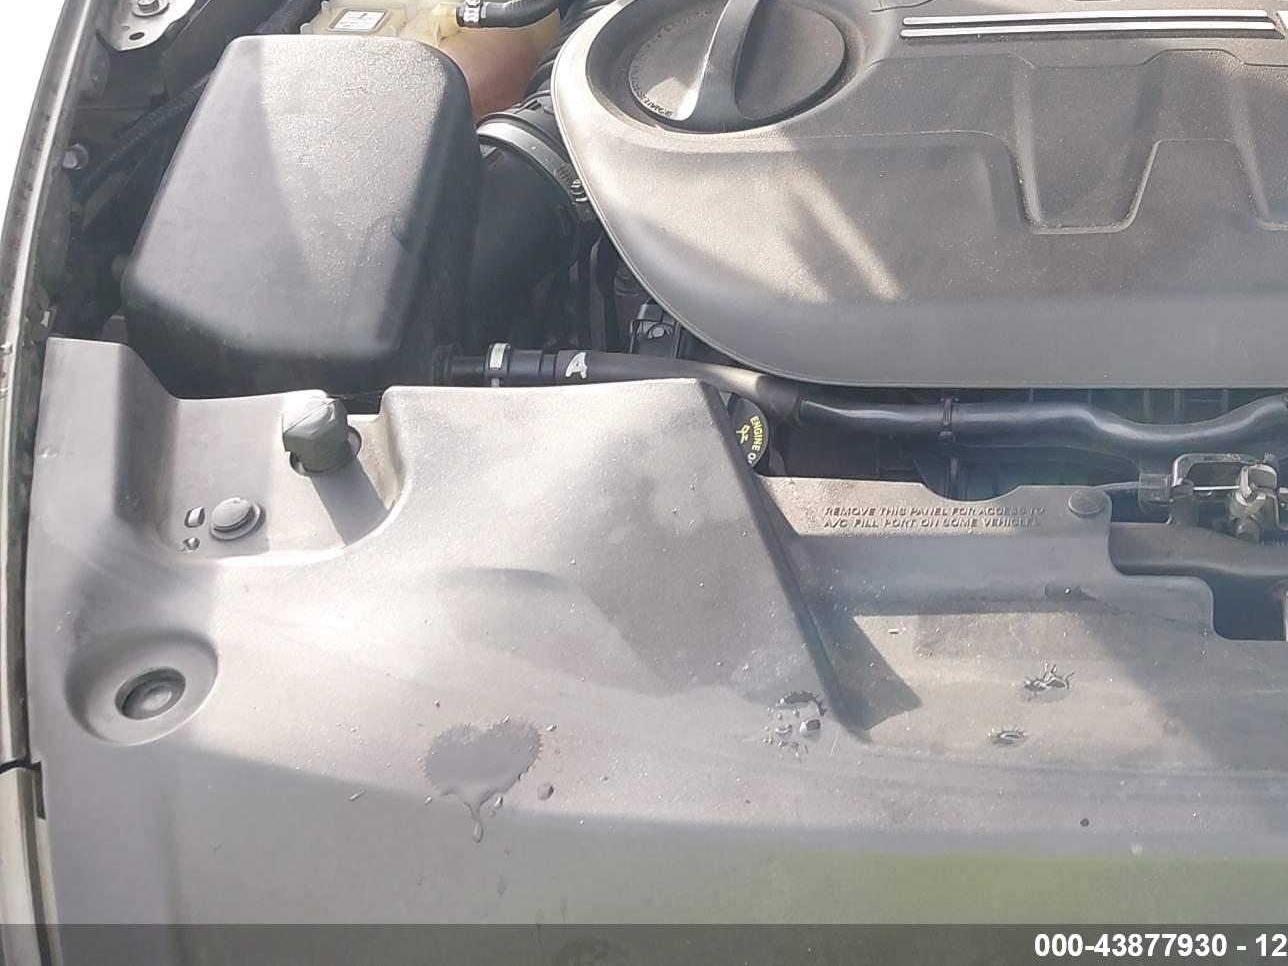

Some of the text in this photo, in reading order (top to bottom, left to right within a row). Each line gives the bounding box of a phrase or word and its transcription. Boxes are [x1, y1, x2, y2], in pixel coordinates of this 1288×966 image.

[565, 351, 589, 379] A
[750, 415, 763, 452] ENGINE
[824, 506, 876, 516] REMOVE
[879, 506, 907, 516] THIS
[910, 507, 948, 516] PANEL
[951, 506, 975, 516] FOR
[823, 518, 848, 528] A/C
[853, 518, 879, 528] FILL
